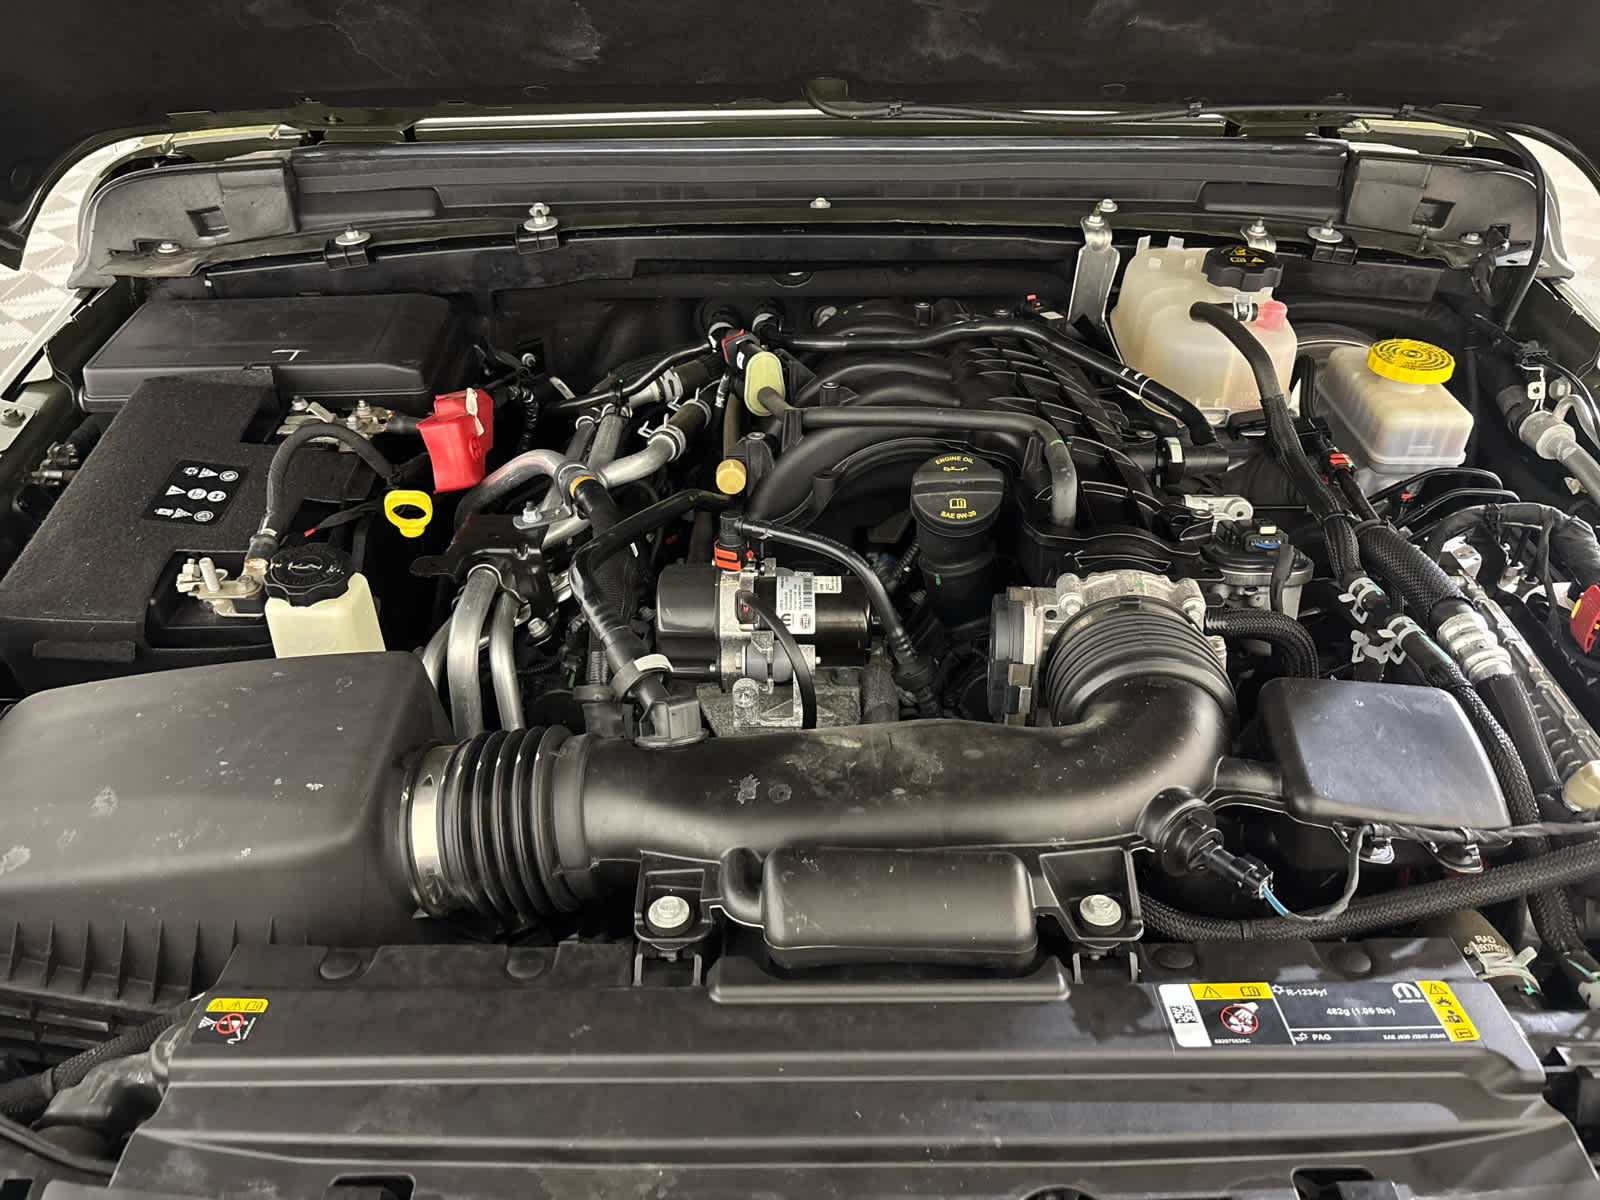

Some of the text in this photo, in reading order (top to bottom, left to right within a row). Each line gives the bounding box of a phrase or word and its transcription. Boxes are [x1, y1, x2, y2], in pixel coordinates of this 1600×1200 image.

[935, 455, 975, 465] ENGINE OIL
[940, 510, 955, 519] SAE
[1311, 1033, 1332, 1041] PAG
